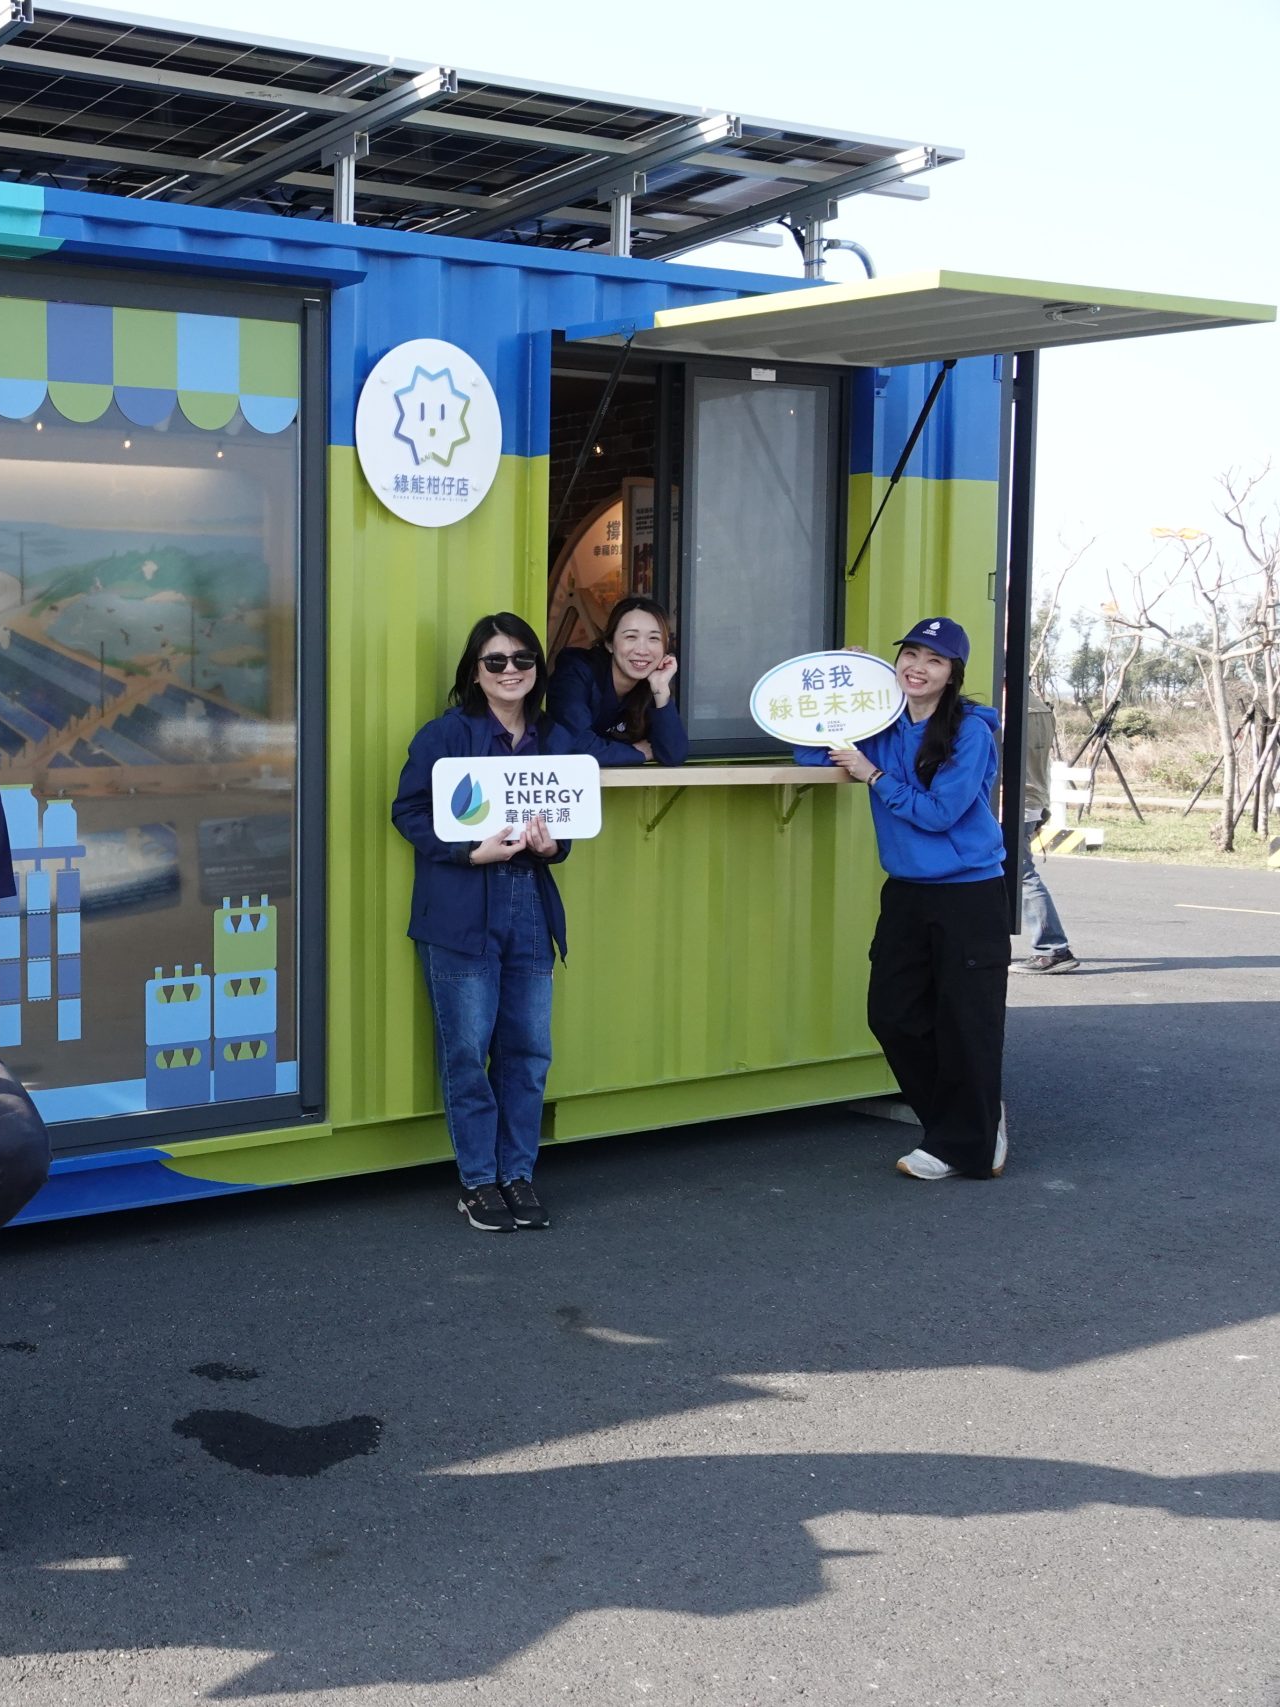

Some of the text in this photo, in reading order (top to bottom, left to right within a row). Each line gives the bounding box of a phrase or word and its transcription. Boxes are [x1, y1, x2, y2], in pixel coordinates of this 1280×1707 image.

[393, 473, 469, 497] 綠能柑仔店
[593, 544, 622, 557] 幸福的
[801, 664, 855, 691] 給我
[504, 771, 559, 786] VENA
[505, 789, 584, 805] ENERGY
[504, 807, 571, 824] 韋能能源
